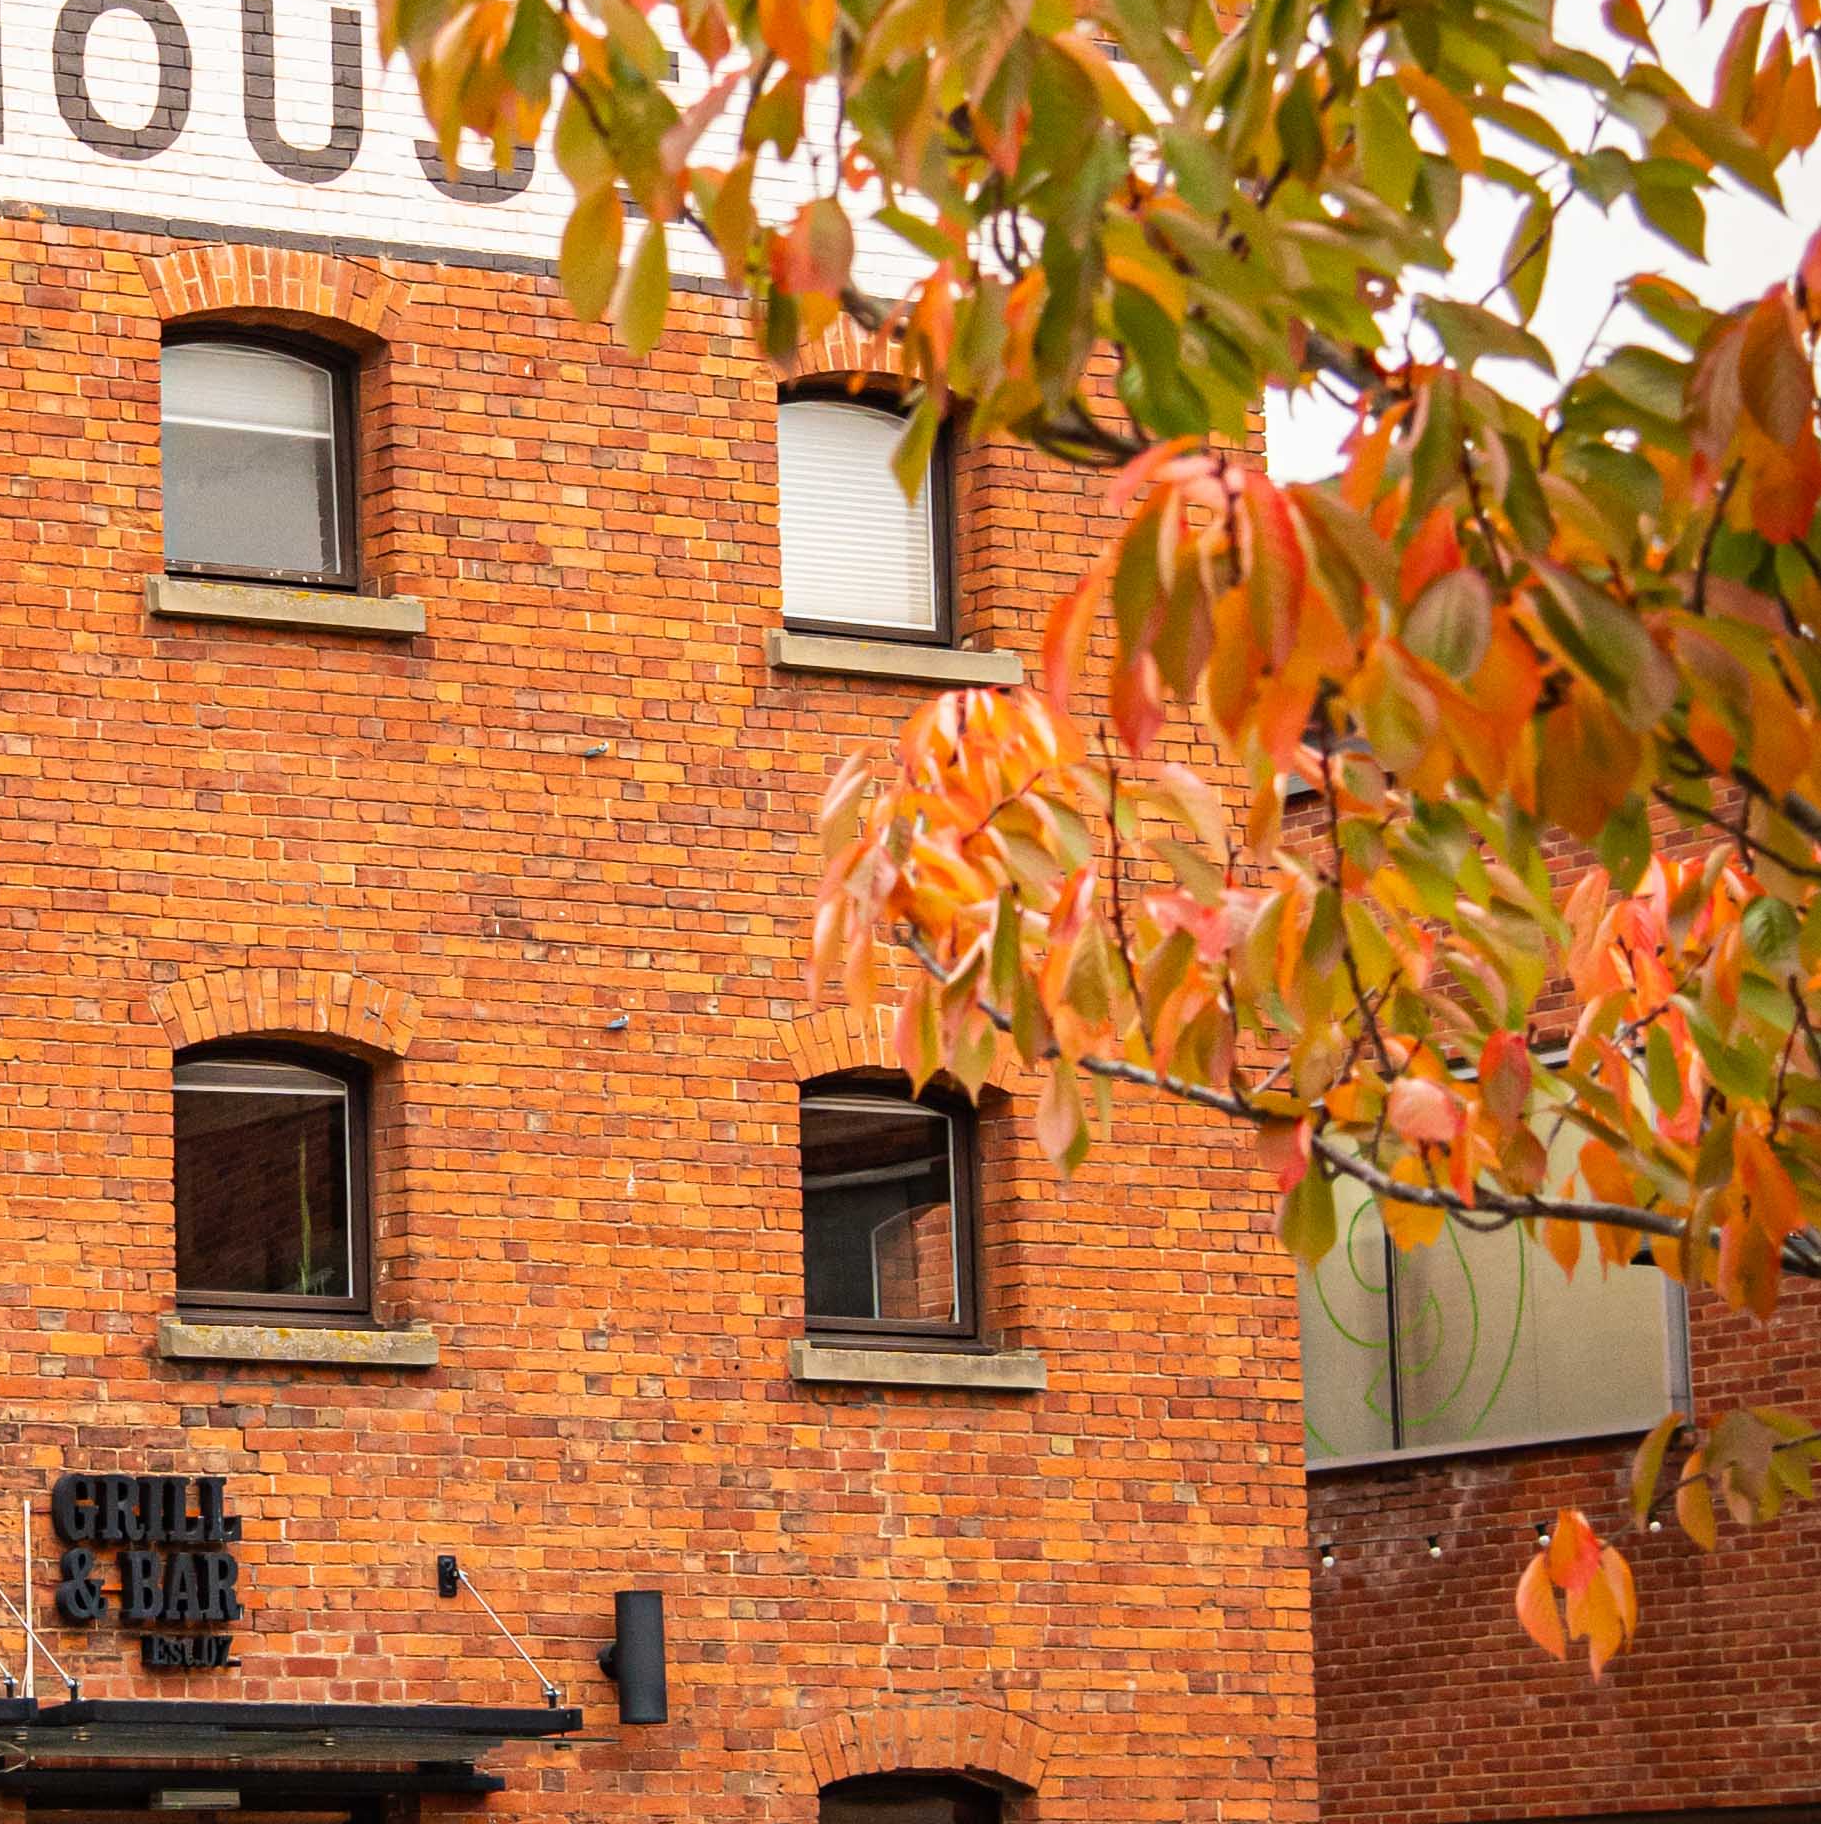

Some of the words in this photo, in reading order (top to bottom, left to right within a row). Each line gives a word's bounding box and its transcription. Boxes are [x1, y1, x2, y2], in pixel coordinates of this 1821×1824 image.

[52, 1474, 242, 1542] GRILL
[57, 1548, 108, 1621] &
[118, 1551, 244, 1621] BAR
